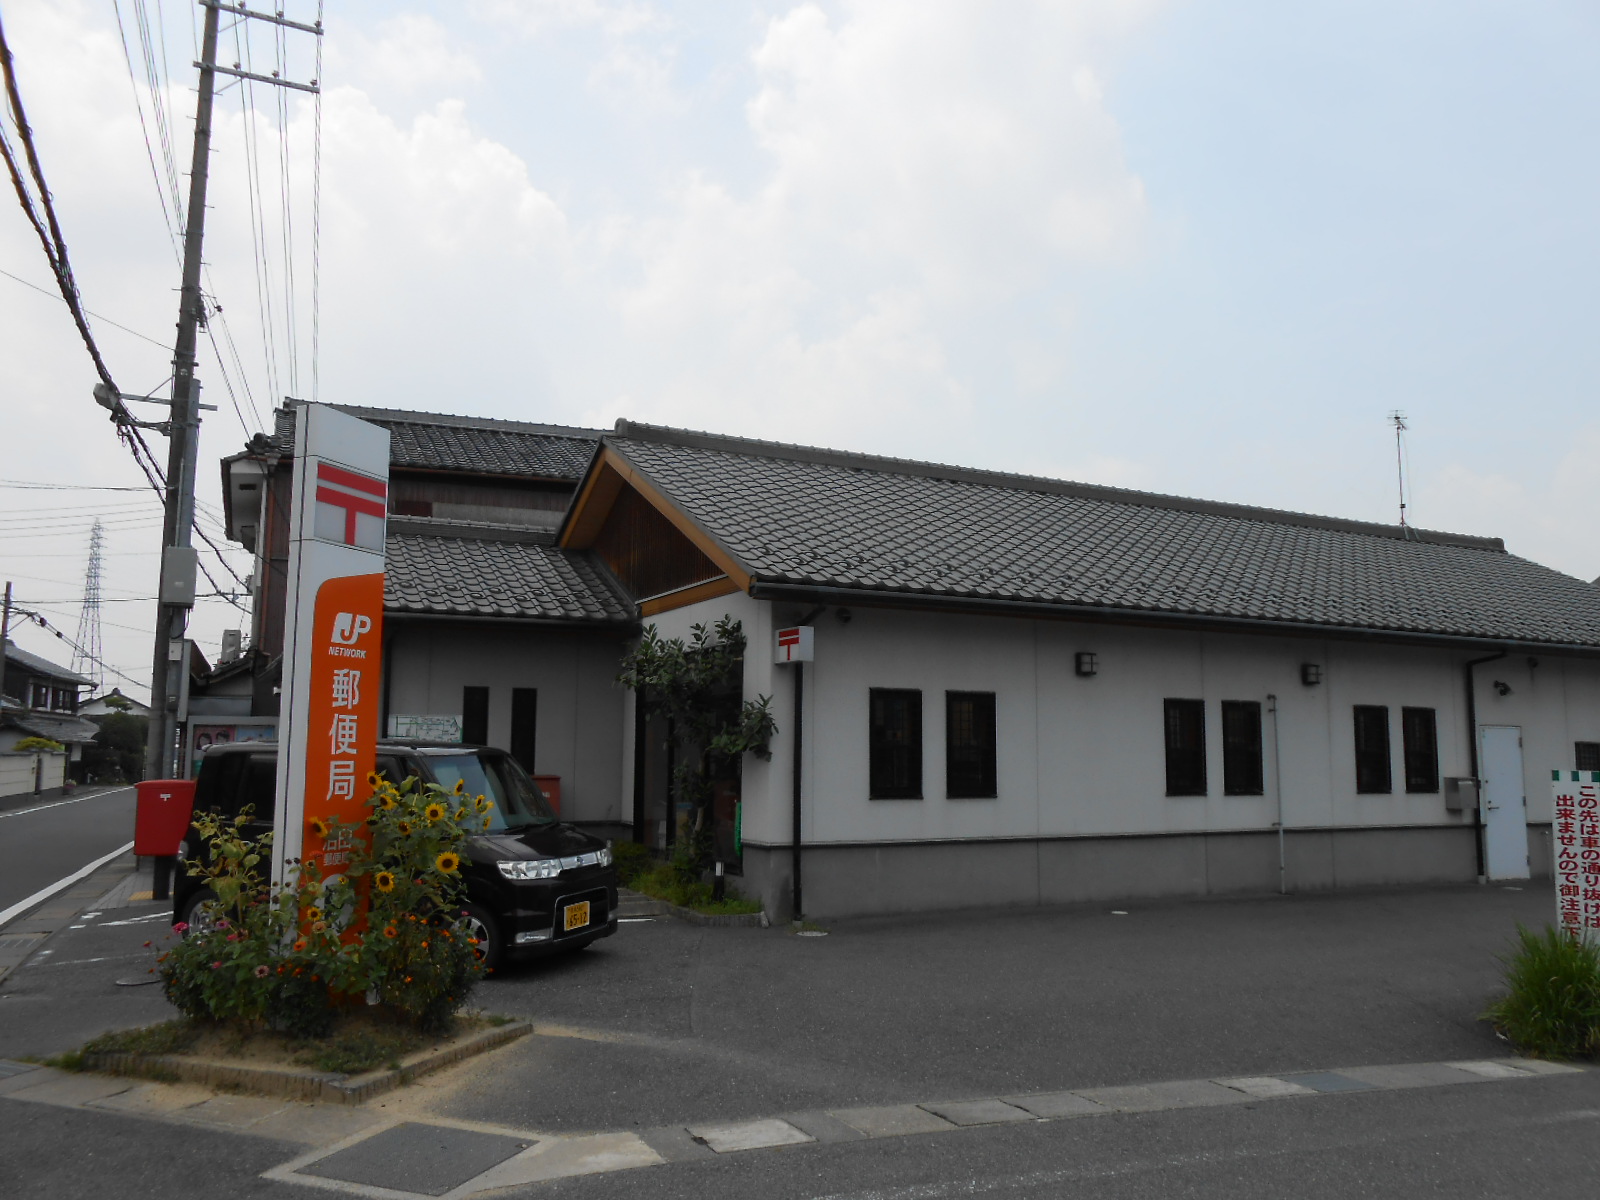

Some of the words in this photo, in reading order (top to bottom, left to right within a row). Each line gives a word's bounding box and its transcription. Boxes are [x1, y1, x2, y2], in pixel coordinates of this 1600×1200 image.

[328, 646, 367, 659] NETWORK
[331, 612, 371, 645] JP
[326, 668, 361, 801] 郵便局
[1556, 794, 1582, 952] 出来ませんので御注意下
[1578, 785, 1600, 929] この先は車の通り抜けは
